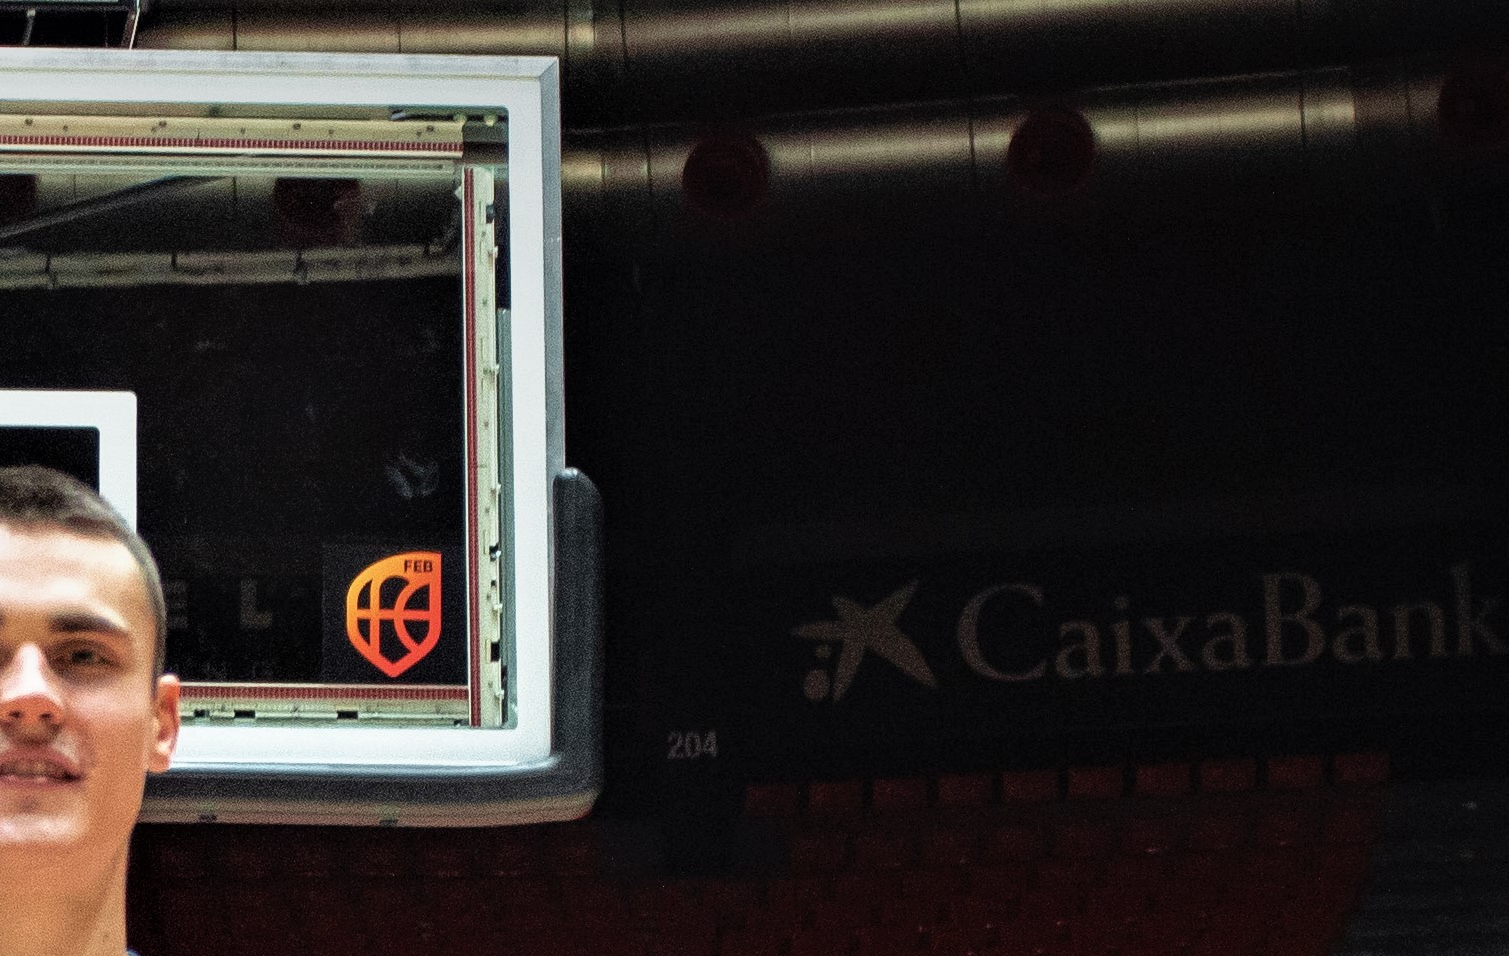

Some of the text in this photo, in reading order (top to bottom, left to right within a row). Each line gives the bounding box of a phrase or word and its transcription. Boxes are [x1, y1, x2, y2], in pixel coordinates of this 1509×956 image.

[403, 559, 433, 573] FEB
[956, 560, 1509, 683] CaixaBank
[667, 729, 720, 760] 204
